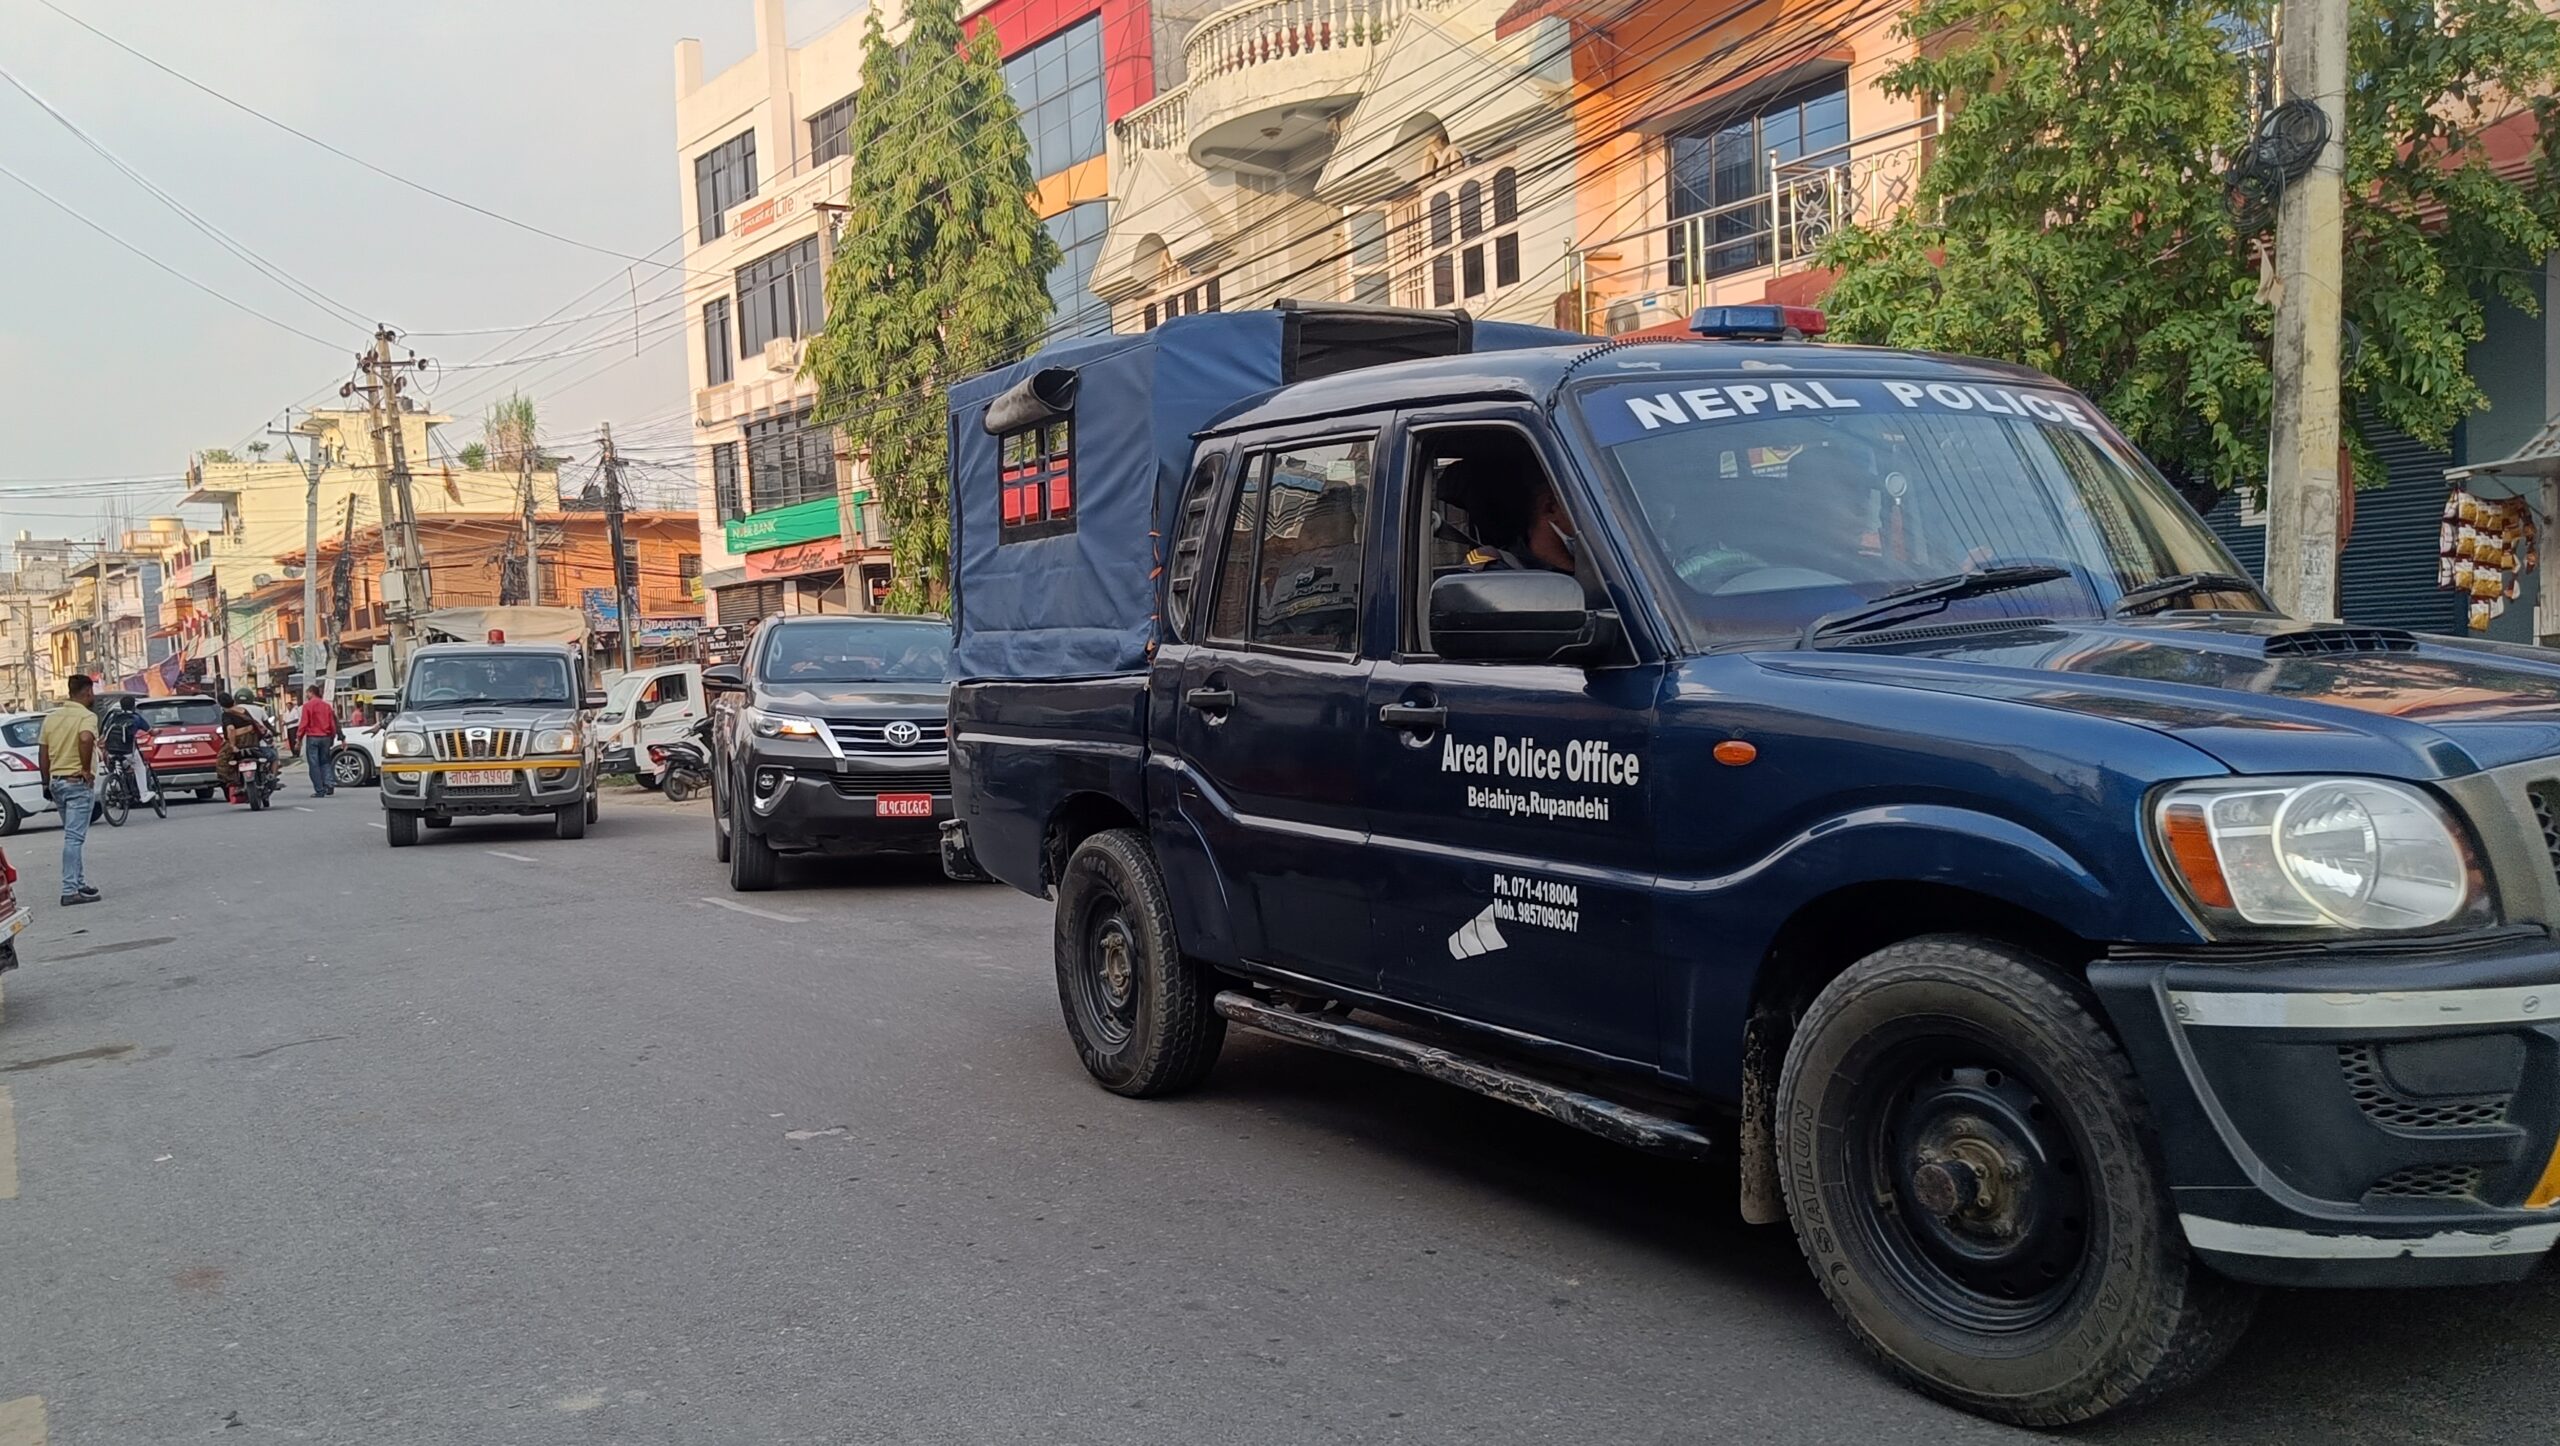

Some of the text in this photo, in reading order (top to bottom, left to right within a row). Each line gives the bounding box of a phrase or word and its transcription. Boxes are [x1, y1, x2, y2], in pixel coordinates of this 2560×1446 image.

[1626, 381, 2099, 433] NEPAL POLICE
[1441, 734, 1640, 785] Area Police Office
[1467, 786, 1609, 821] Belahiya,Rupandehi
[1494, 874, 1578, 907] Ph.071-418004
[1494, 898, 1579, 932] Mob.9857090347
[1793, 1099, 1835, 1254] SAILUN
